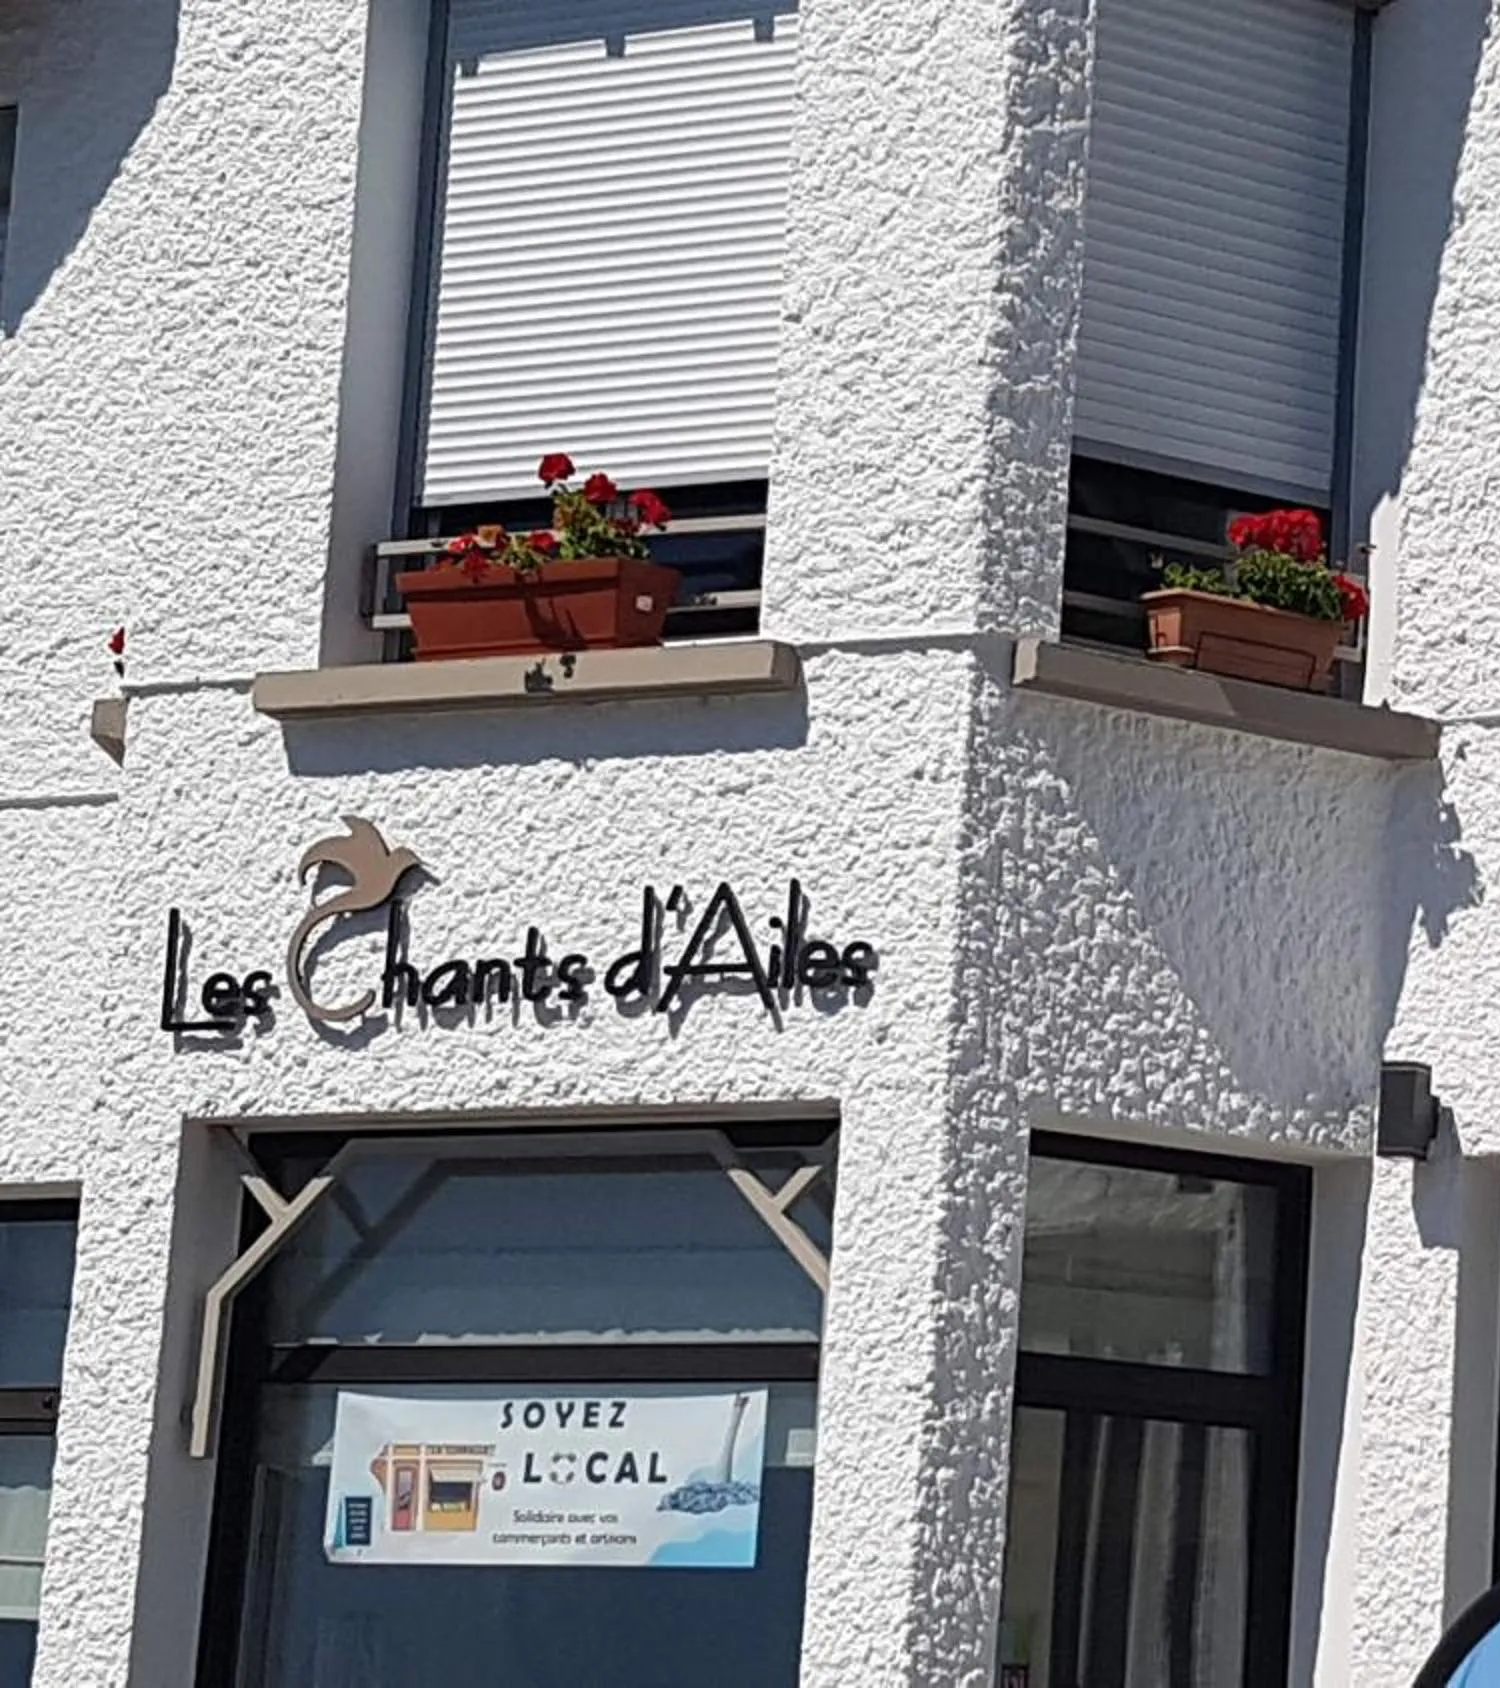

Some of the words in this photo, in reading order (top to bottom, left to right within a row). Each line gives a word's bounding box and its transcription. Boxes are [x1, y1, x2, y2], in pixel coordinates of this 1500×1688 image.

[160, 908, 272, 1032] Les
[287, 884, 589, 1022] Chants
[605, 878, 874, 1032] d'Ailes
[501, 1401, 627, 1429] SOYEZ
[522, 1451, 668, 1484] LOCAL
[513, 1509, 565, 1523] Solidaire
[574, 1532, 587, 1545] et
